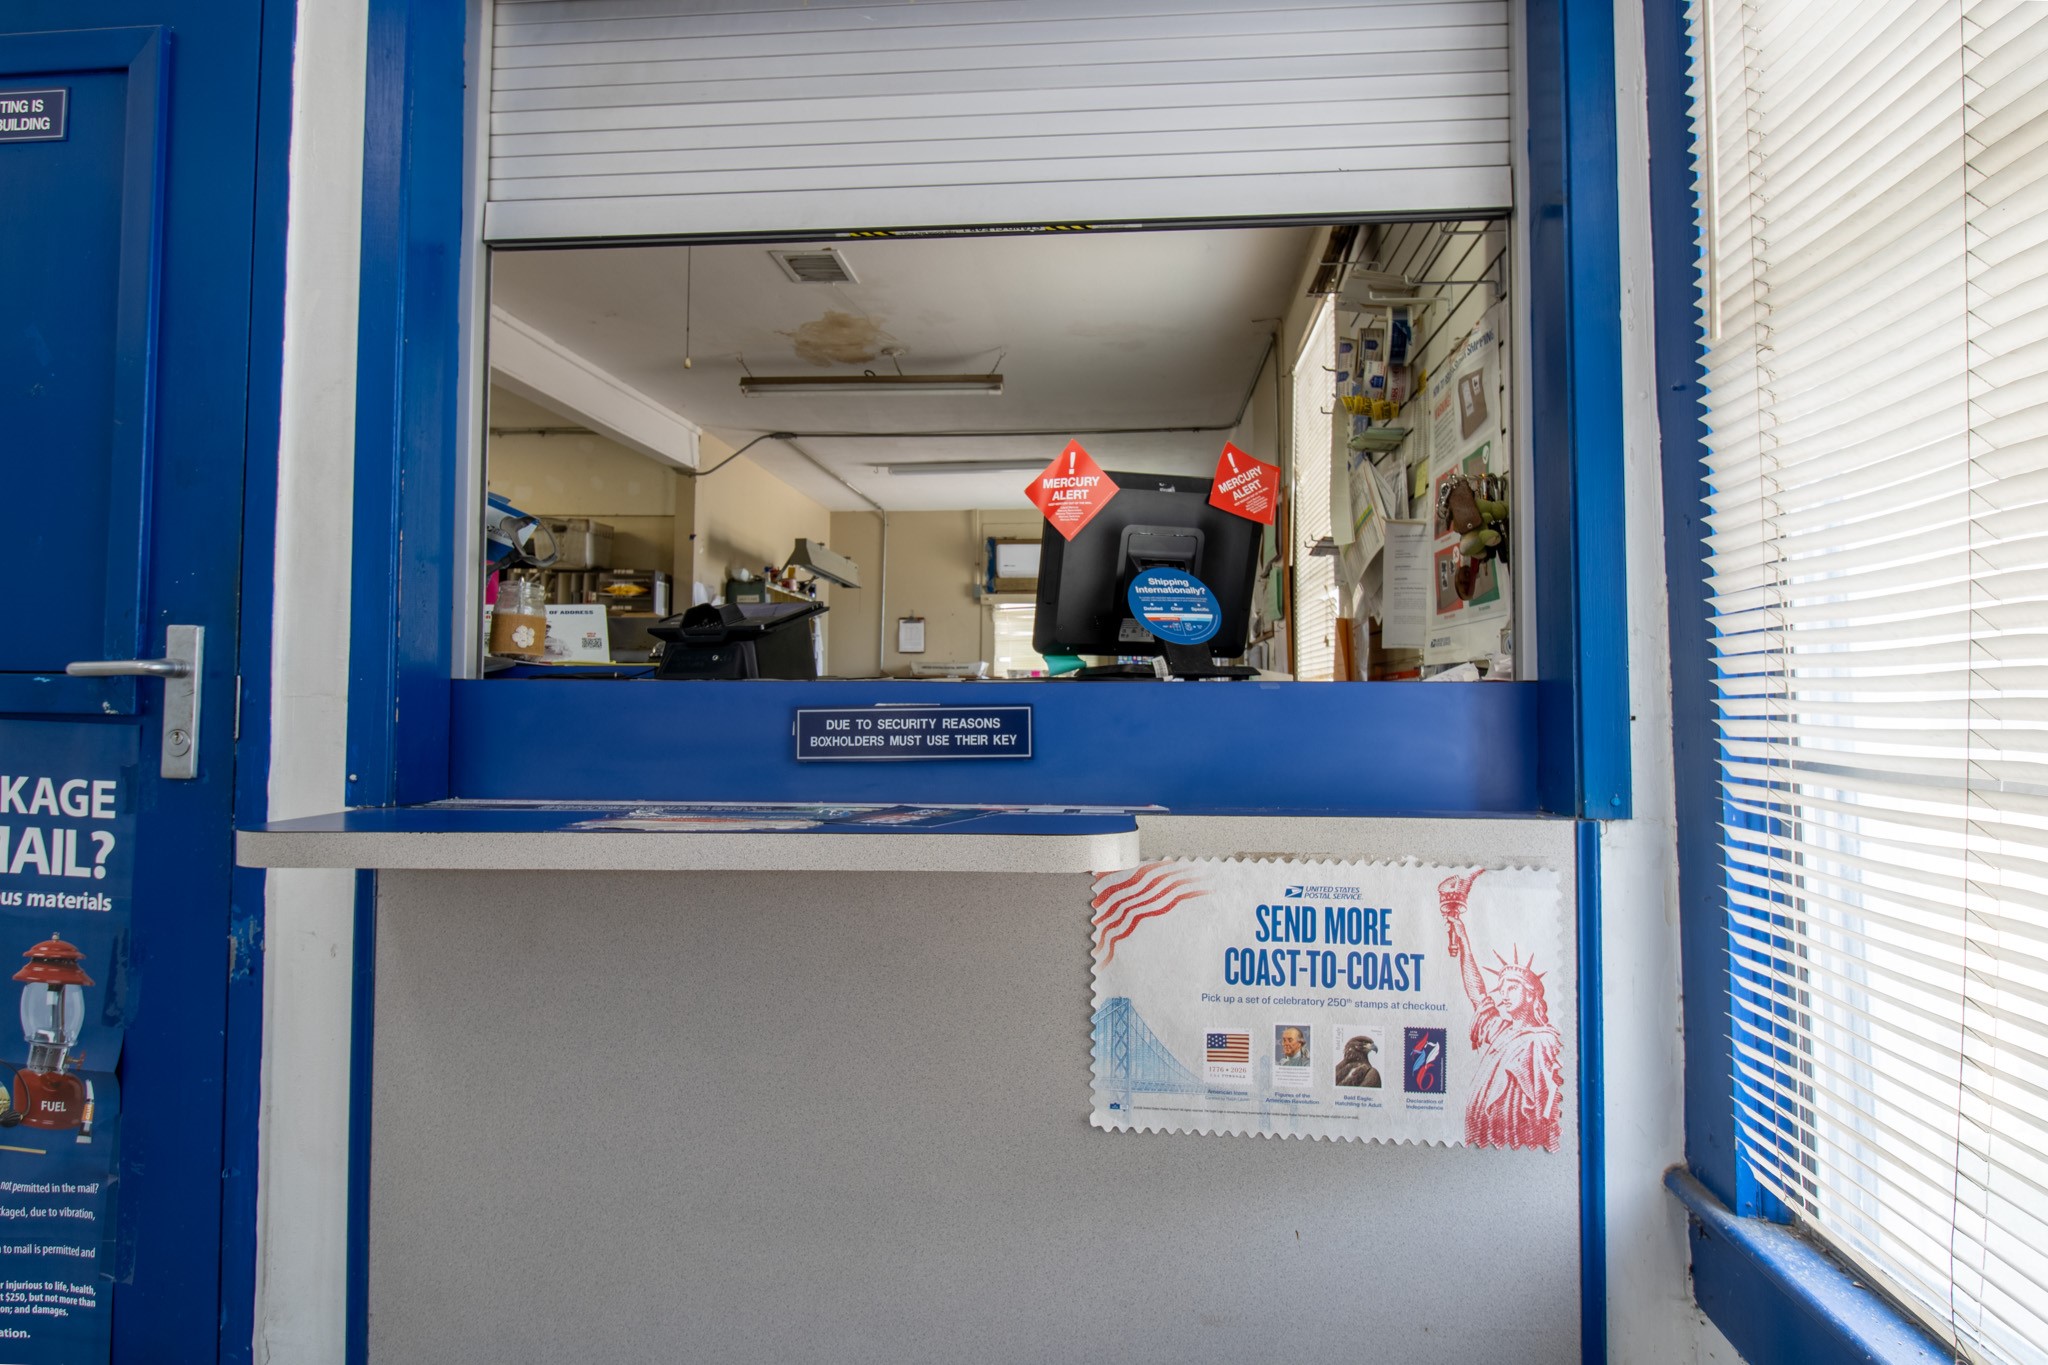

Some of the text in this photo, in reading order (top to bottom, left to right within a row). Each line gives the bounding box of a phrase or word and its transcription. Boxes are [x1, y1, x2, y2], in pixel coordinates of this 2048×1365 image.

[32, 99, 44, 112] IS
[1043, 476, 1100, 489] MERCURY
[1218, 465, 1263, 494] MERCURY
[1052, 489, 1089, 501] ALERT
[1232, 479, 1262, 501] ALERT
[1148, 577, 1189, 587] Shipping
[1135, 586, 1205, 595] Internationally?
[826, 718, 1000, 730] DUE TO SECURITY REASONS
[810, 734, 1017, 747] BOXHOLDERS MUST USE THEIR KEY
[1, 775, 117, 819] KAGE
[27, 891, 112, 912] materials
[1256, 904, 1392, 946] SEND MORE
[1224, 947, 1425, 992] COAST-TO-COAST
[1201, 993, 1220, 1002] Pick
[1224, 996, 1235, 1004] up
[1261, 996, 1271, 1004] of
[1273, 996, 1325, 1007] celebratory
[1327, 998, 1352, 1007] 250th
[1354, 1001, 1388, 1010] stamps
[1391, 1001, 1400, 1009] at
[1402, 1001, 1448, 1011] checkout.
[1274, 1091, 1294, 1099] Figures
[41, 1100, 67, 1112] FUEL
[0, 1181, 99, 1194] not permitted in the mail?
[30, 1206, 47, 1217] due
[48, 1207, 58, 1217] to
[59, 1206, 96, 1221] vibration,
[4, 1243, 96, 1258] to mail is permitted and
[6, 1280, 42, 1292] injurious
[44, 1281, 53, 1290] to
[54, 1281, 70, 1293] life,
[70, 1283, 96, 1297] health,
[5, 1293, 28, 1303] $250,
[28, 1293, 43, 1302] but
[44, 1294, 58, 1302] not
[59, 1295, 77, 1305] more
[78, 1296, 96, 1308] than
[14, 1304, 31, 1314] and
